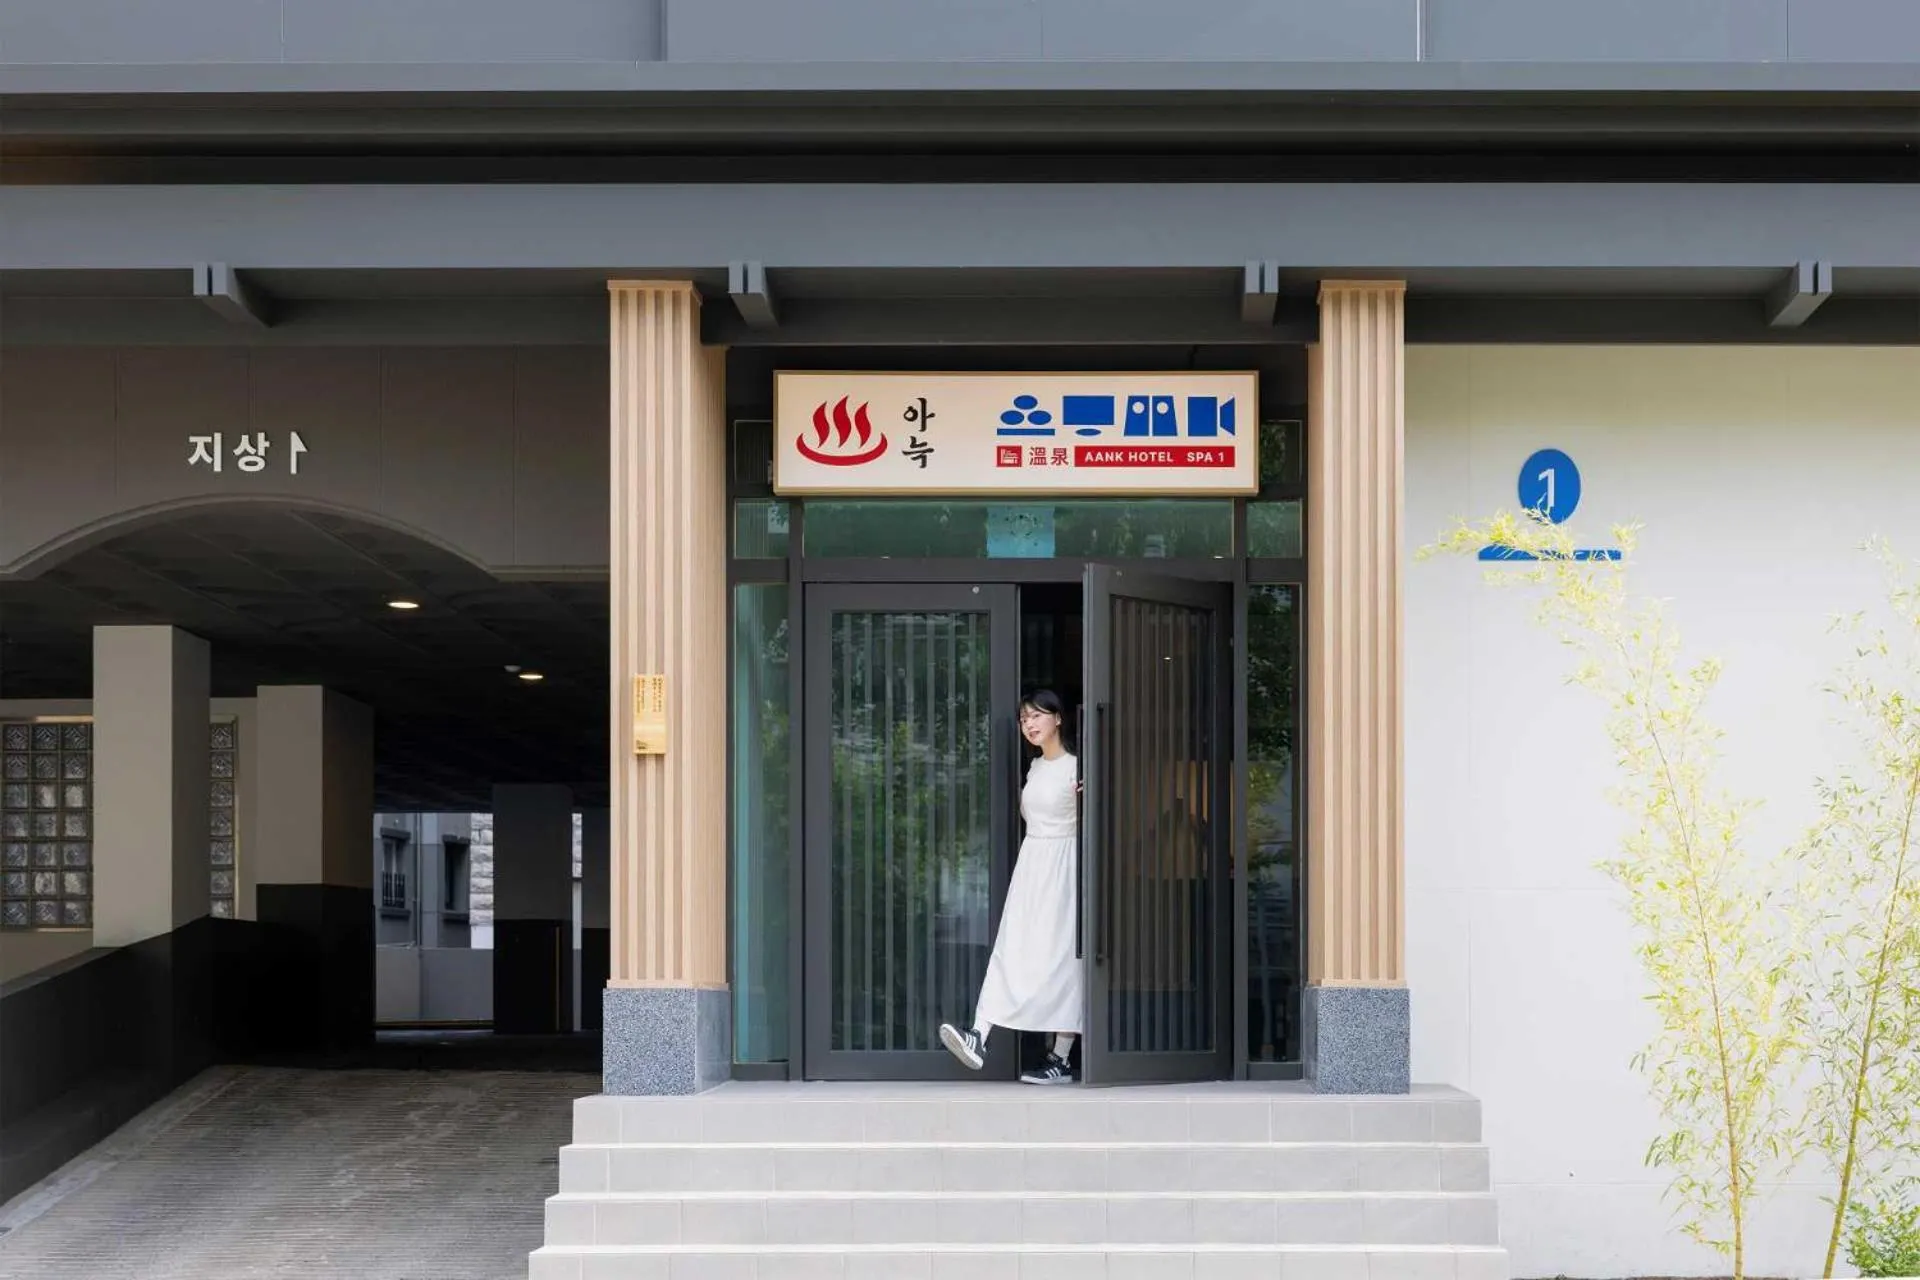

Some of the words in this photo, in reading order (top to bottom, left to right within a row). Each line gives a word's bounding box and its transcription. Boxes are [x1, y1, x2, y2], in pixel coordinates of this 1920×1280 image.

[188, 432, 270, 472] 지상
[902, 397, 936, 469] 아늑
[1084, 451, 1124, 462] AANK
[1128, 451, 1174, 462] HOTEL
[1187, 451, 1214, 462] SPA
[1218, 451, 1225, 462] 1
[1538, 468, 1555, 509] 1
